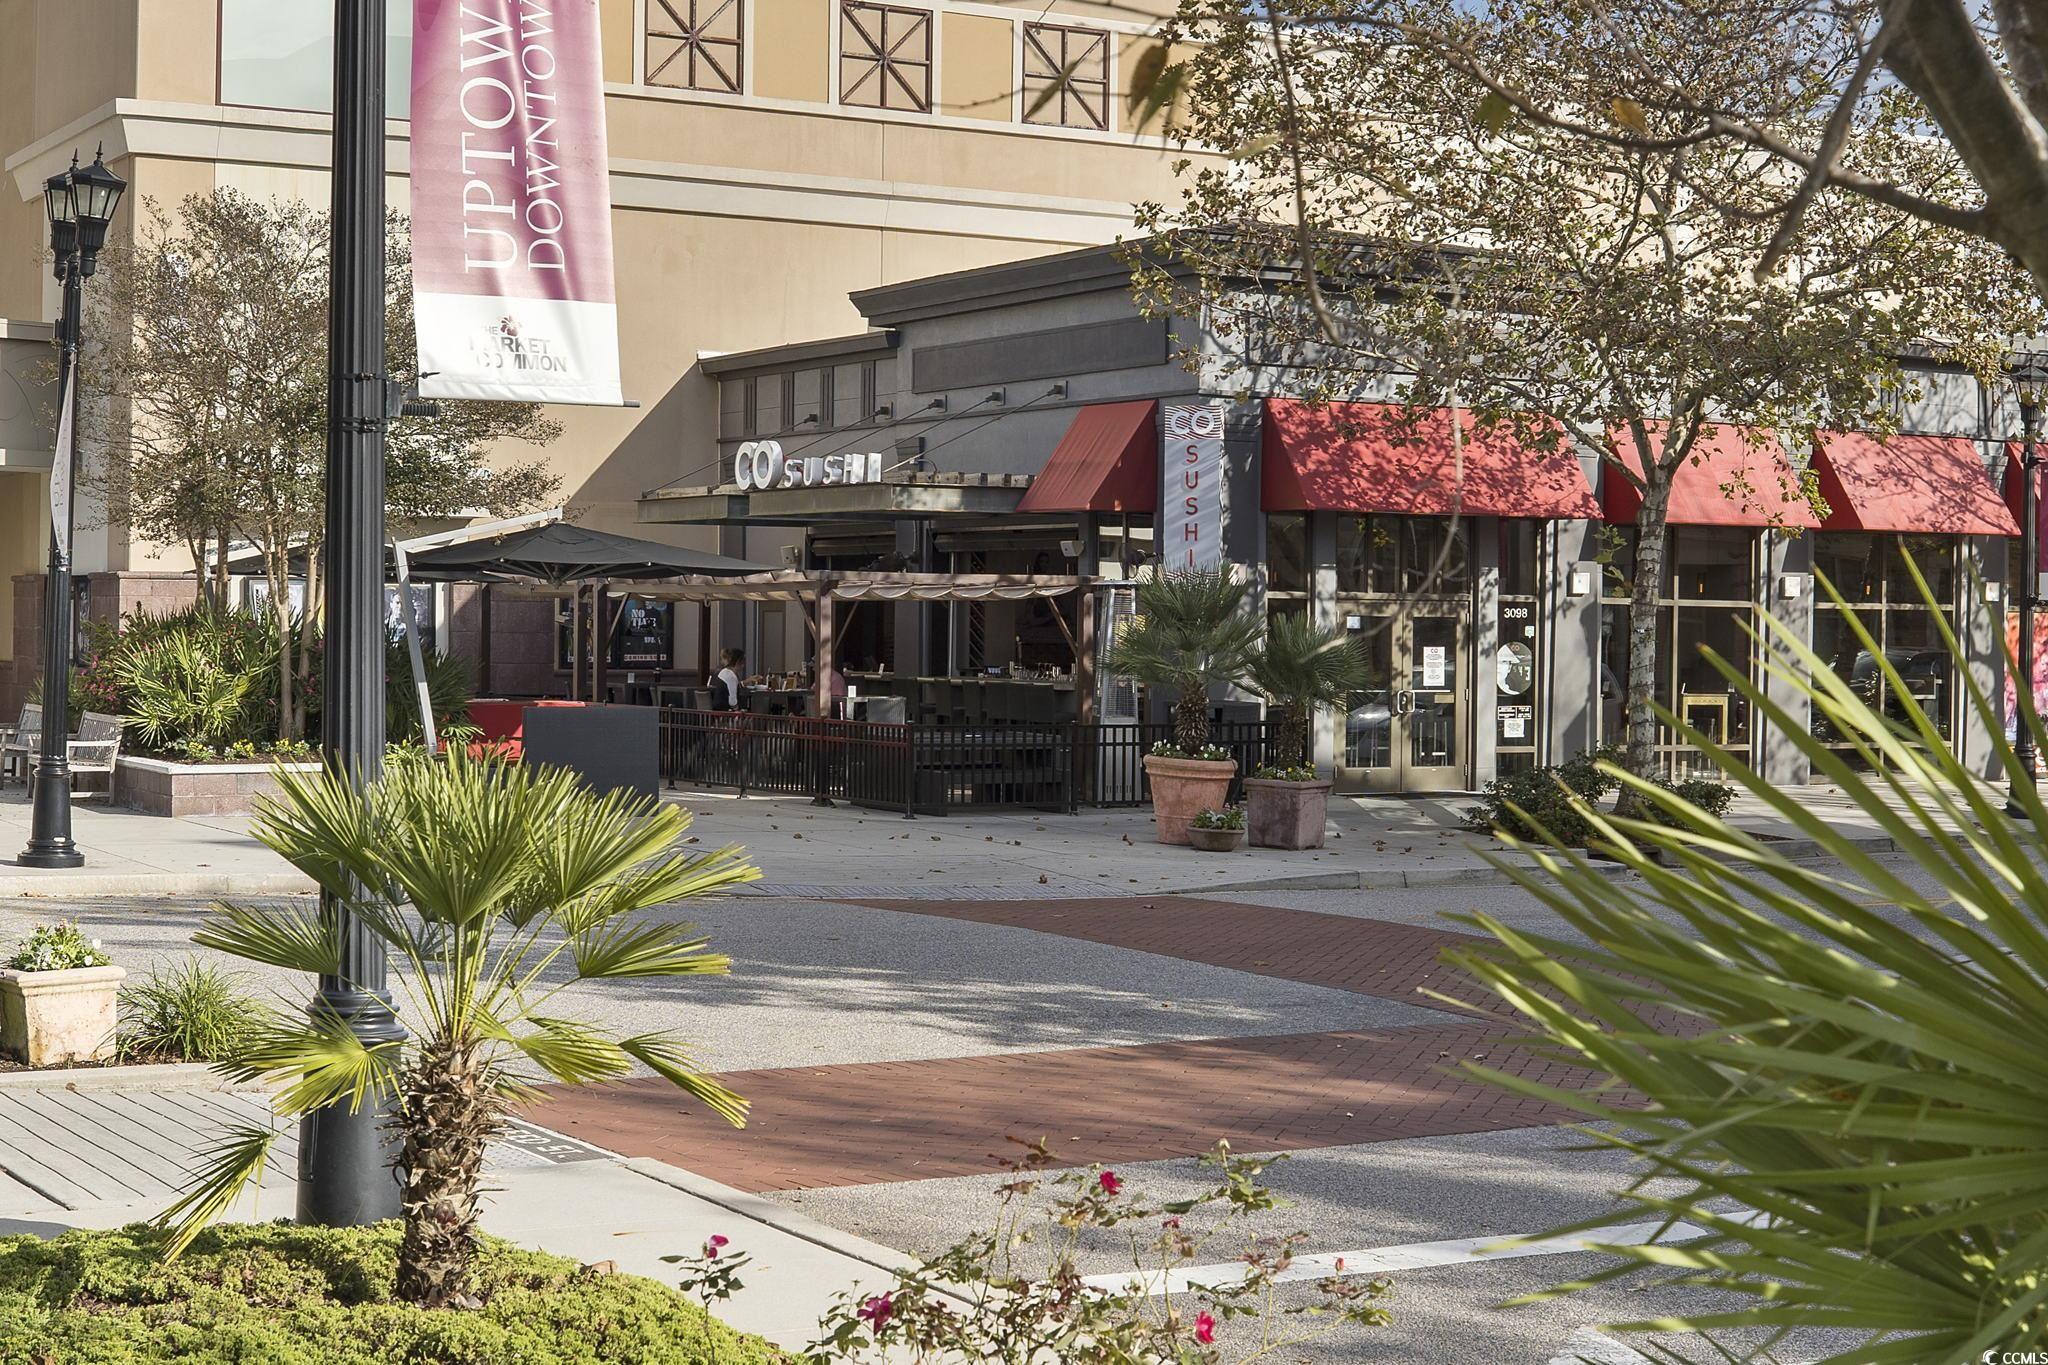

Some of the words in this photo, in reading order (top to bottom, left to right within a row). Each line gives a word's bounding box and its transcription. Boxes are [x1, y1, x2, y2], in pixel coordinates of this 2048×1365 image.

[459, 0, 518, 273] UPTOW
[520, 0, 565, 273] DOWNTOW
[735, 440, 783, 490] CO
[1170, 410, 1215, 435] CO
[1184, 444, 1199, 568] SUSHI
[1504, 608, 1528, 618] 3098
